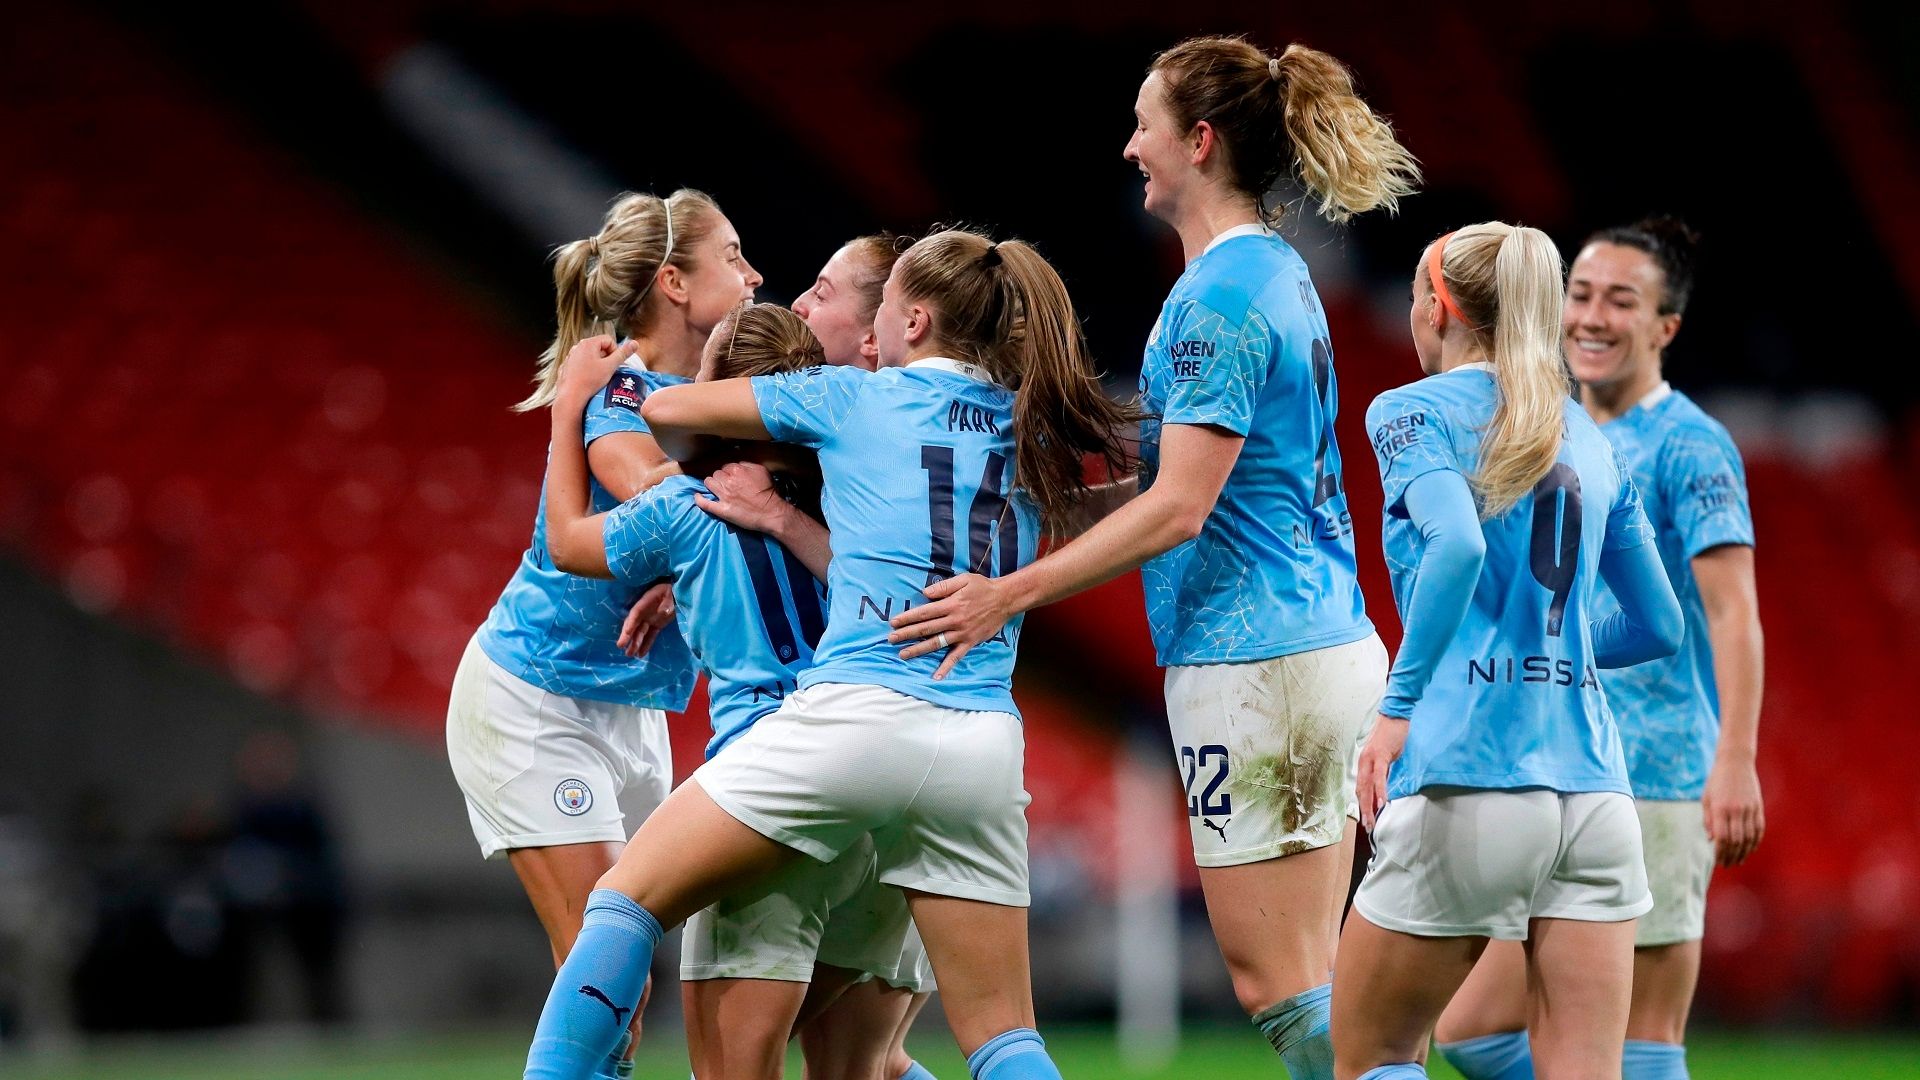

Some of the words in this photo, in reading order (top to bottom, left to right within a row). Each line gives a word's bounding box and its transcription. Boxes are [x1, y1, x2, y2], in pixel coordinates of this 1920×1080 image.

[1170, 340, 1216, 360] NXEN
[1173, 360, 1202, 377] TRE
[623, 399, 638, 408] CUP
[948, 399, 1001, 437] PARK
[1380, 428, 1419, 460] TIRE
[921, 444, 1018, 587] 16
[1293, 510, 1352, 549] NISS
[1529, 462, 1582, 637] 9
[1468, 656, 1599, 691] NISSA
[1181, 744, 1231, 816] 22
